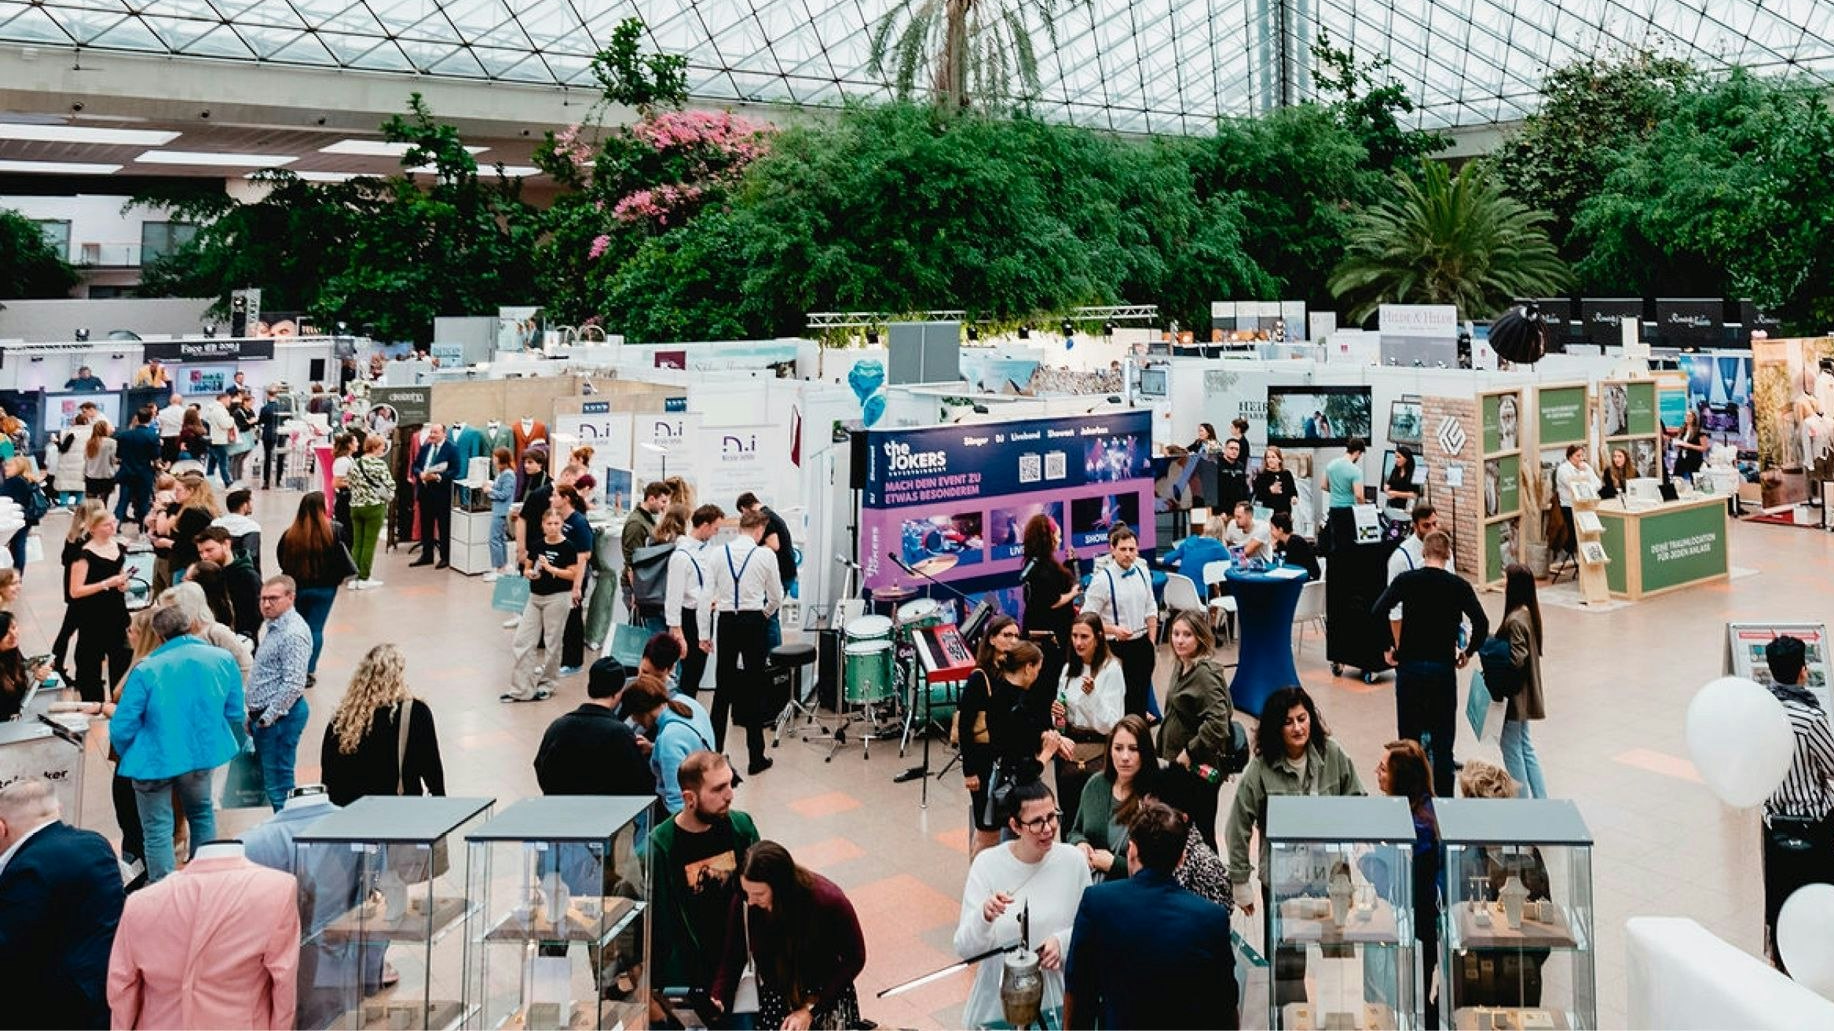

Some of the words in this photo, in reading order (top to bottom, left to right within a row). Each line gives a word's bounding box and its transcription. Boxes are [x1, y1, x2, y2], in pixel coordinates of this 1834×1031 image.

[883, 440, 910, 456] the
[888, 450, 947, 471] JOKERS
[885, 479, 914, 492] MACH
[915, 477, 937, 489] DEIN
[938, 473, 967, 486] EVENT
[968, 472, 982, 483] ZU
[885, 491, 918, 505] ETWAS
[920, 484, 980, 501] BESONDEREM
